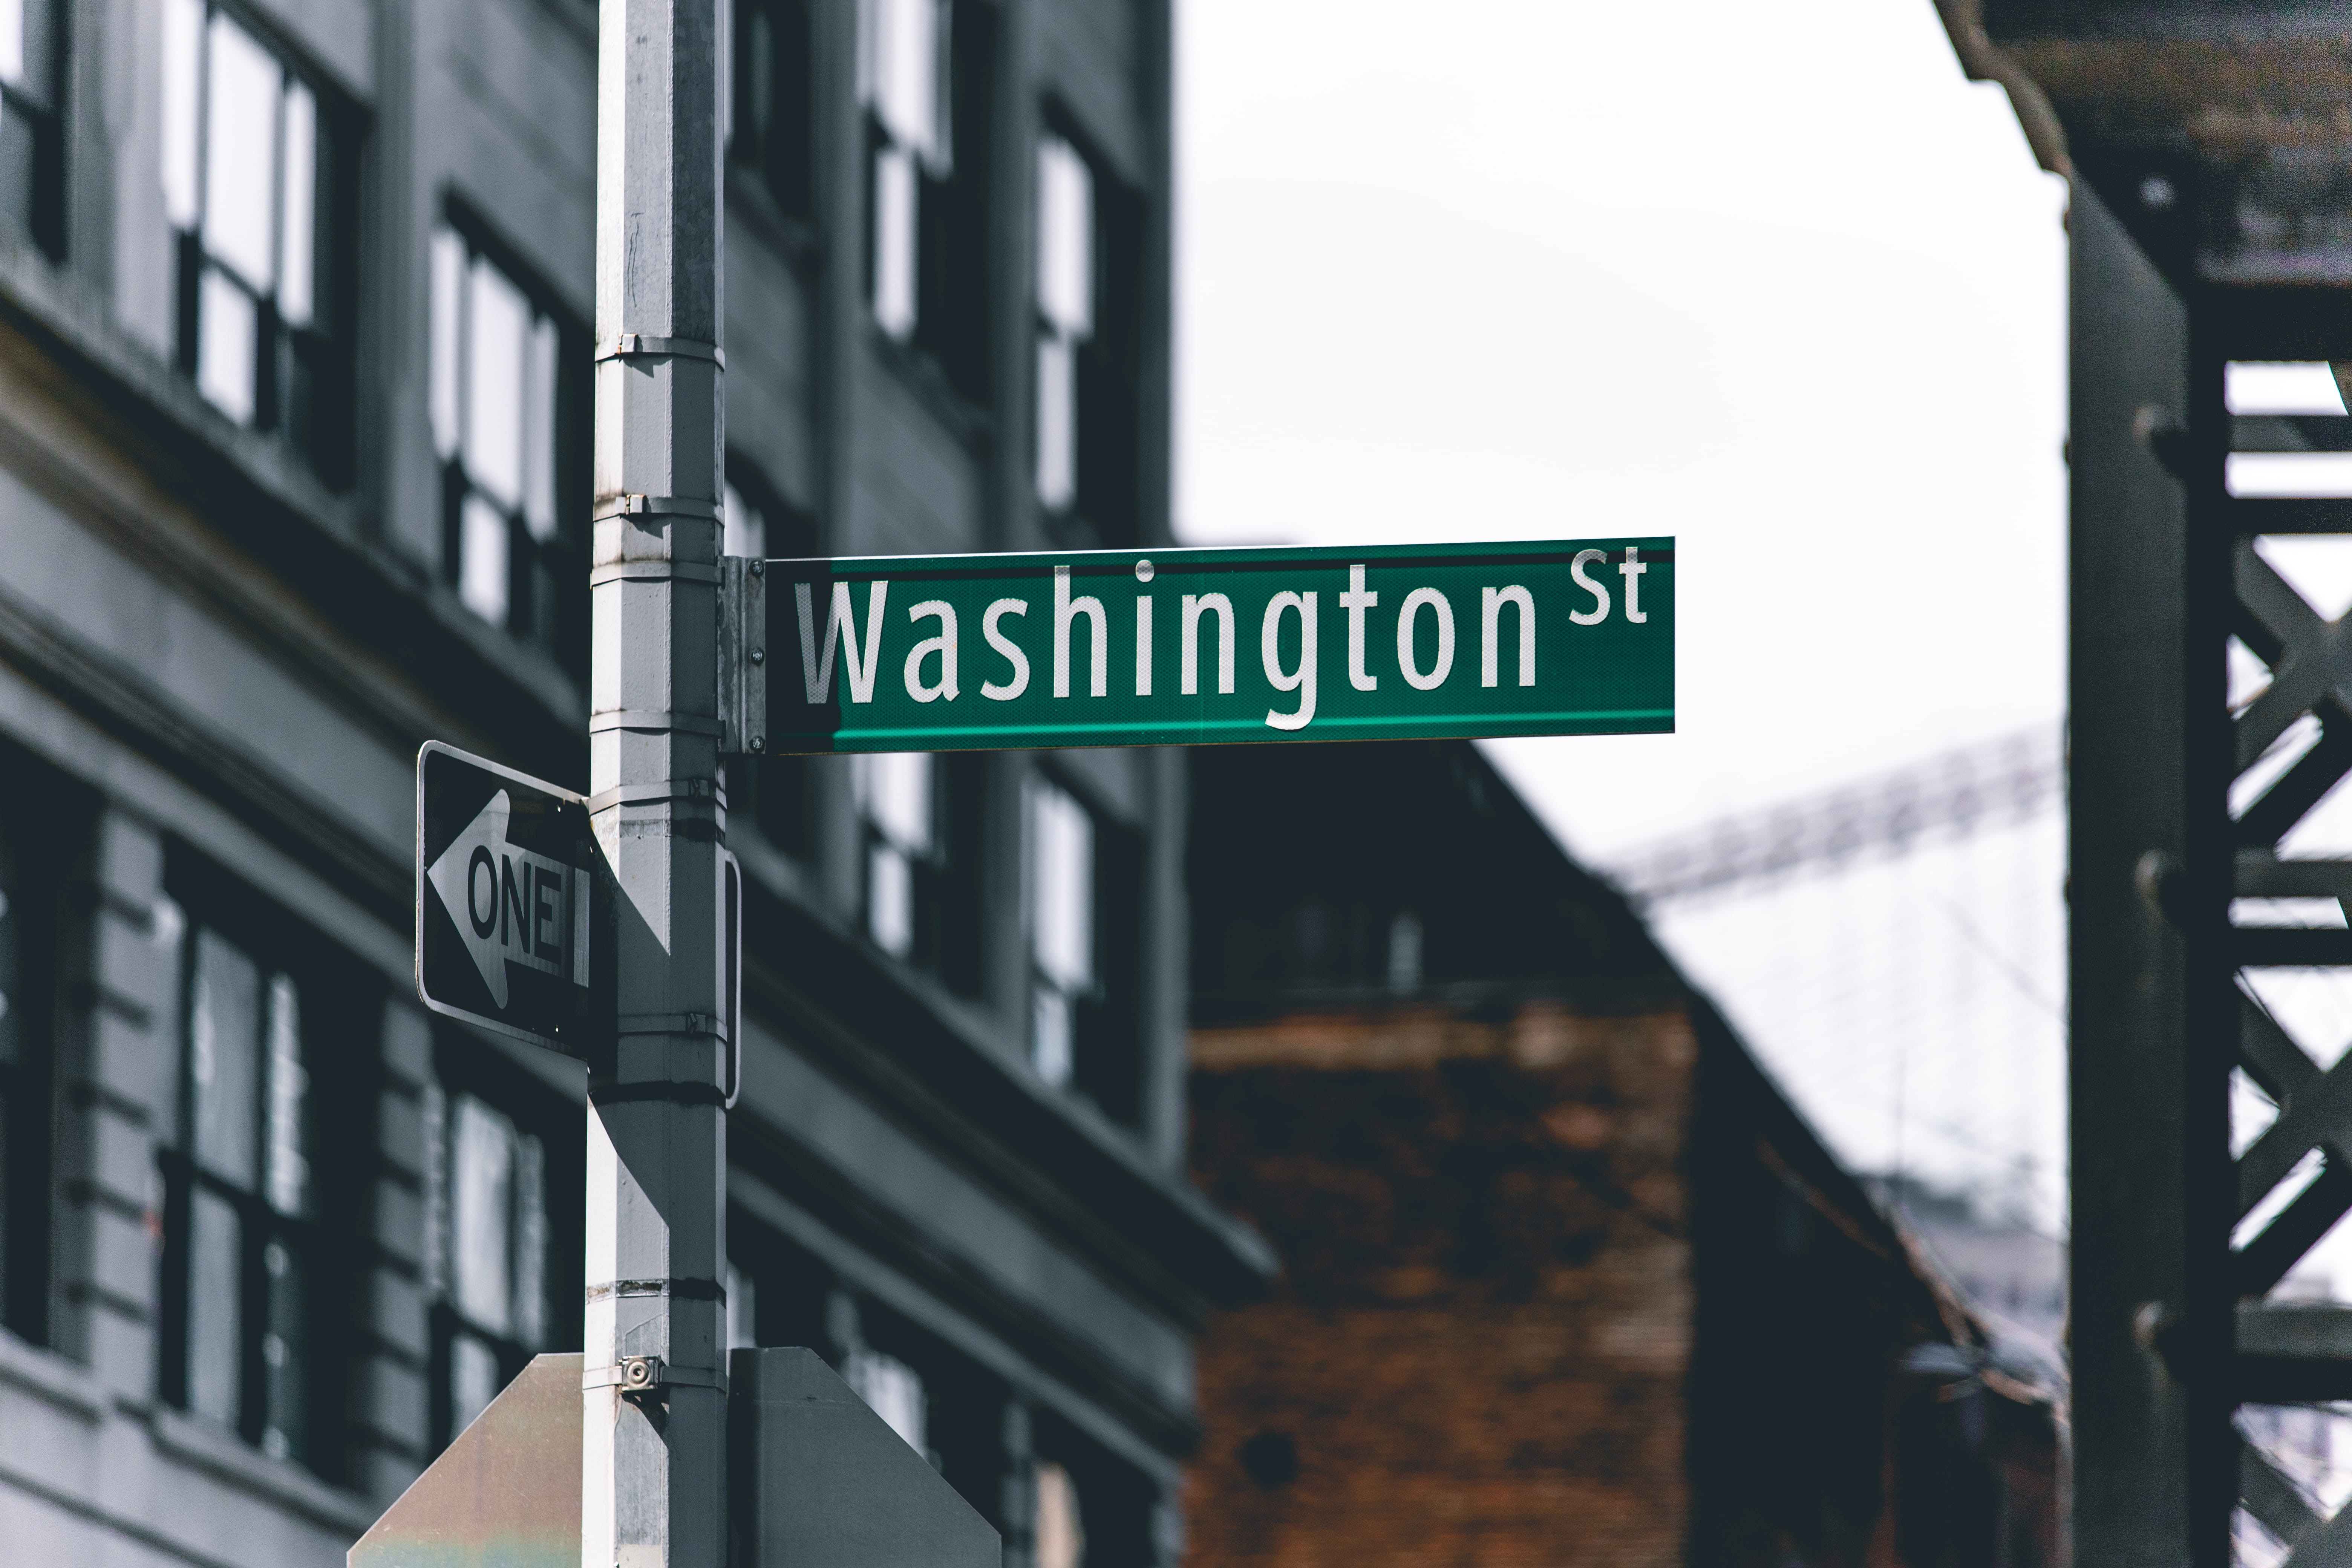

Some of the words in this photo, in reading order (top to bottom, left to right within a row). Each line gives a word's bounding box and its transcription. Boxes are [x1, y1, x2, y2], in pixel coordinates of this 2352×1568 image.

[794, 560, 1536, 730] Washington
[1569, 547, 1647, 625] St
[468, 845, 561, 965] ONE
